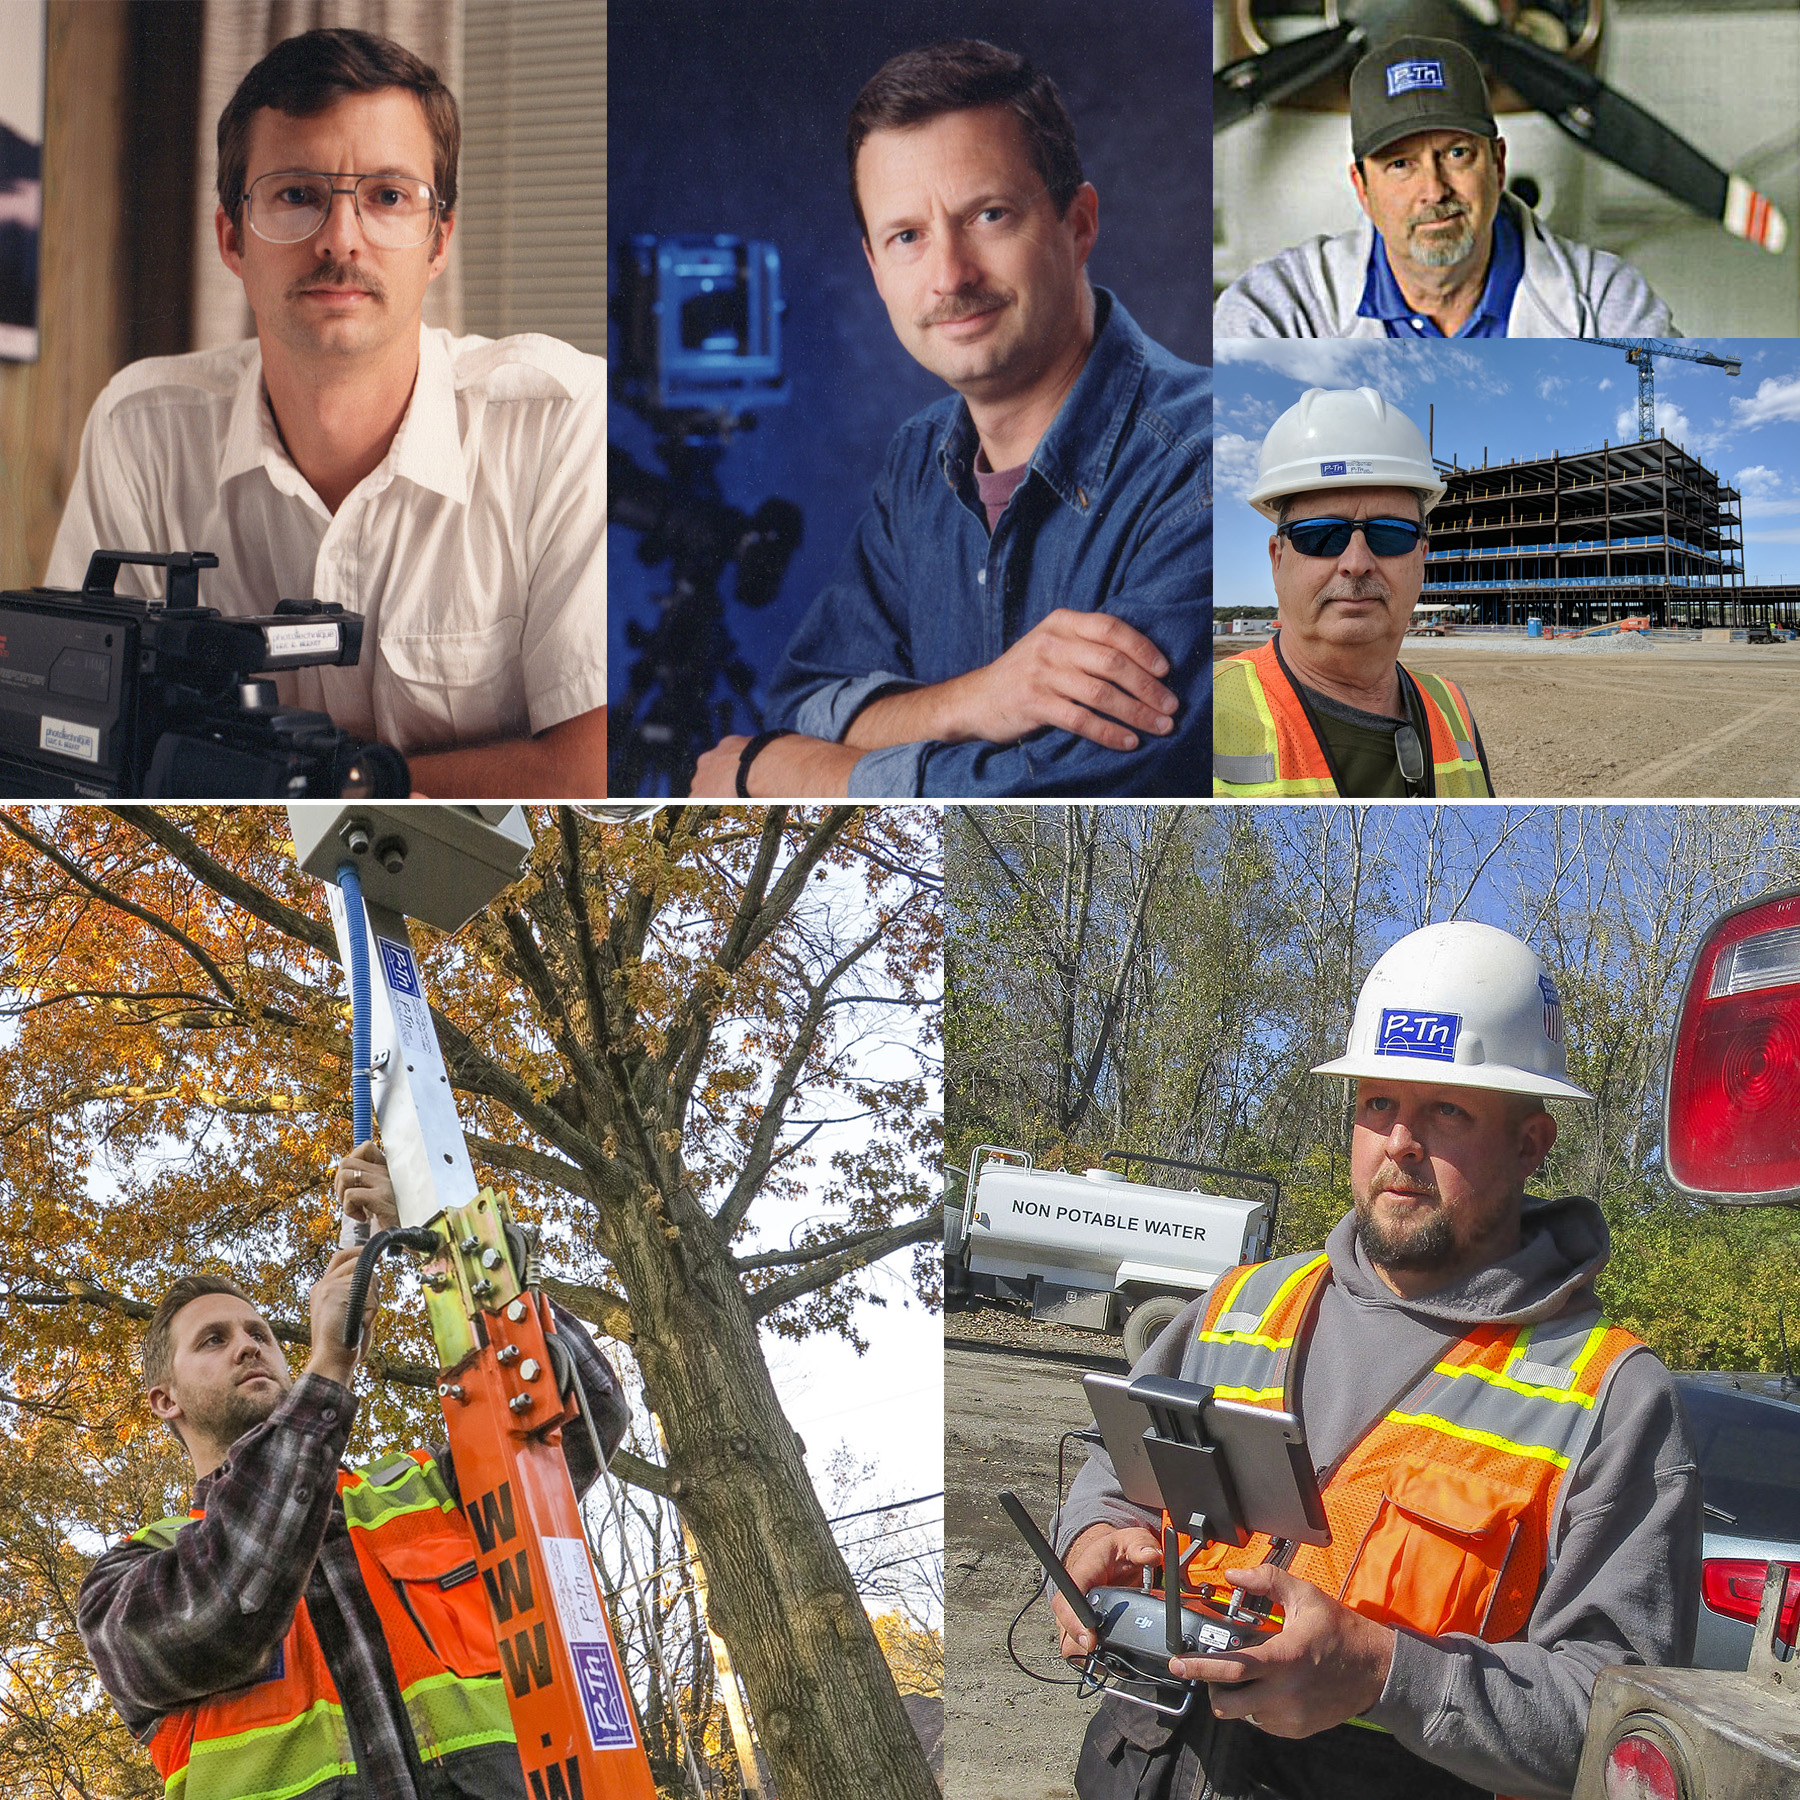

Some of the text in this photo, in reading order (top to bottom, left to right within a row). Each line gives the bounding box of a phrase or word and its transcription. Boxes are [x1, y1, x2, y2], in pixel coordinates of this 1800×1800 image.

[1394, 67, 1436, 85] P-Tn
[1324, 465, 1343, 473] P-Tn
[75, 783, 108, 799] Panasonic
[390, 948, 413, 989] P-Tn
[1384, 1014, 1450, 1043] P-Tn
[1012, 1199, 1207, 1242] NON POTABLE WATER
[584, 1653, 617, 1732] P-Tn
